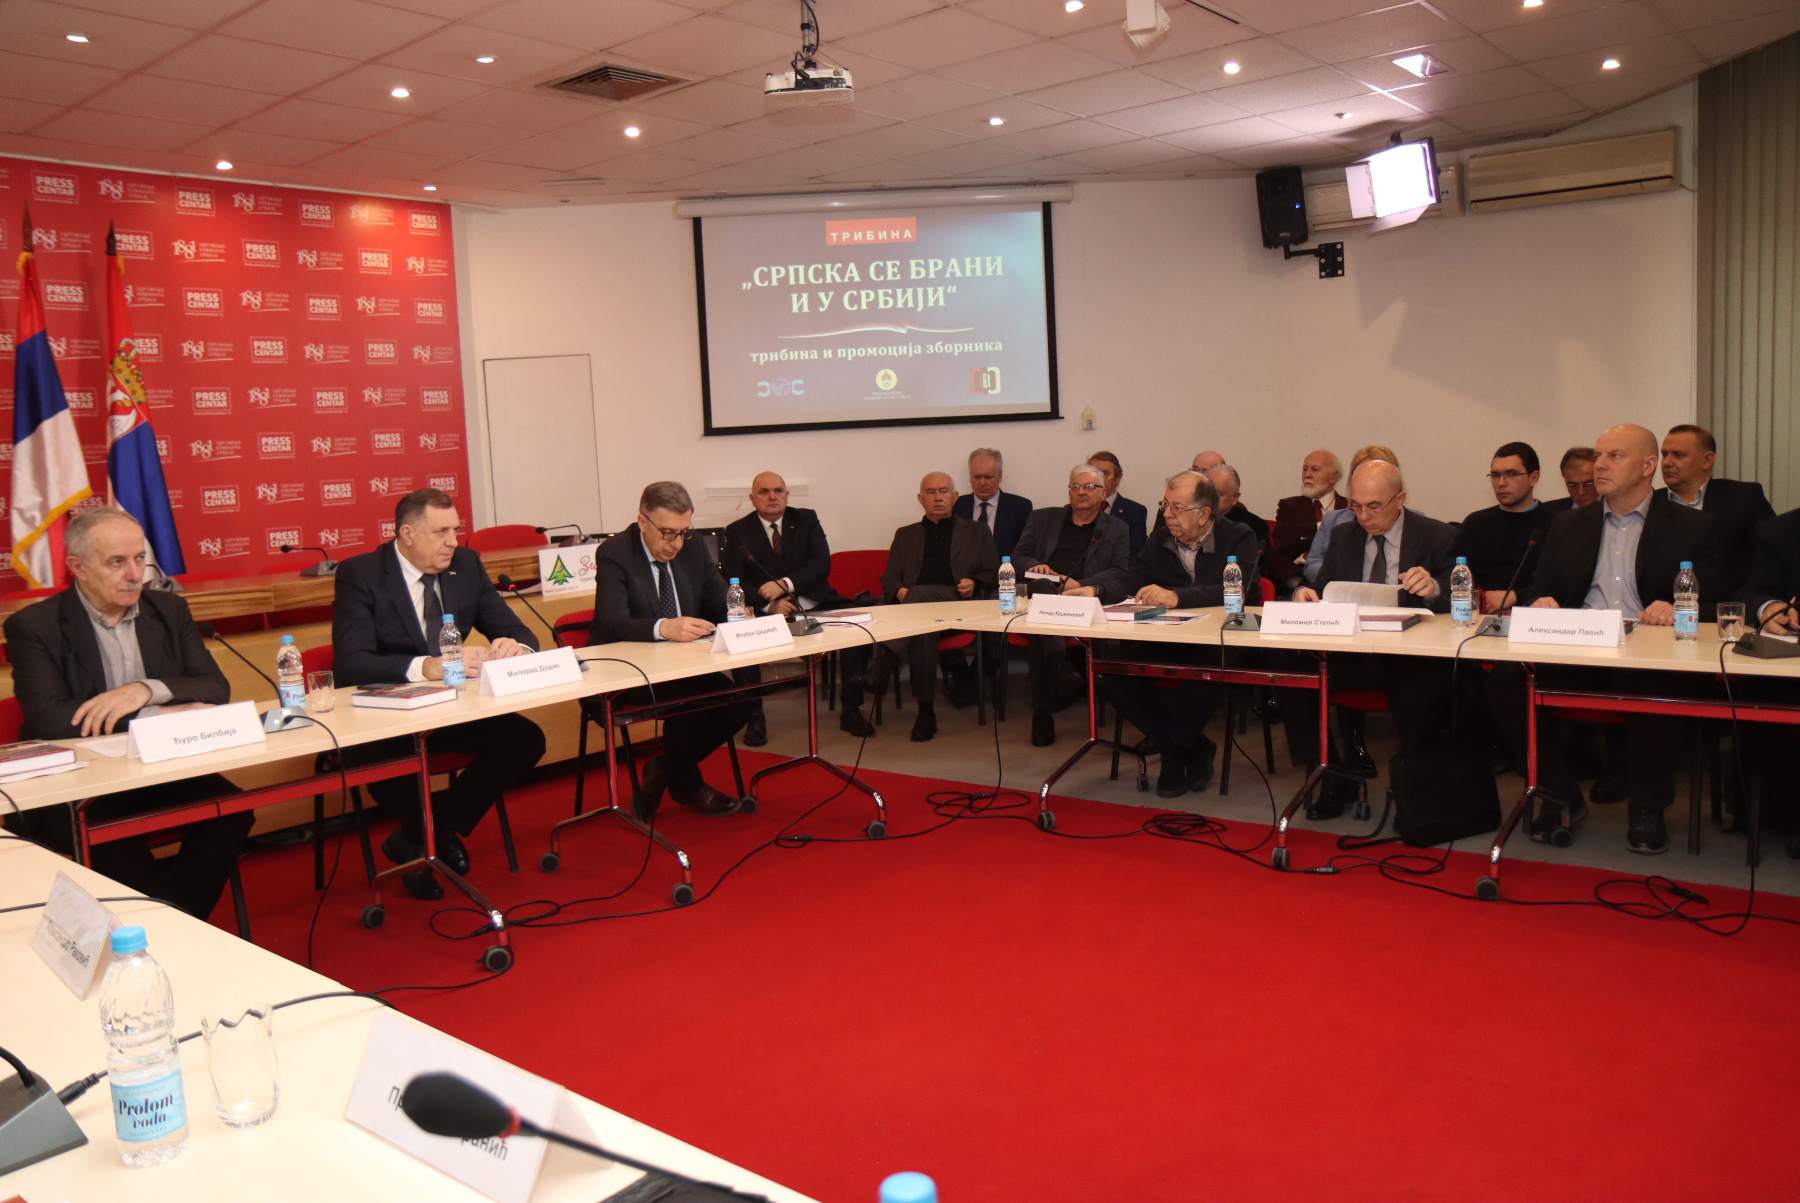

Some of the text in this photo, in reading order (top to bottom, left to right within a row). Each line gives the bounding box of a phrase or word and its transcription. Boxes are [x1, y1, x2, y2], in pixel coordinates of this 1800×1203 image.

[36, 176, 74, 189] PRESS
[36, 186, 75, 196] CENTAR
[178, 191, 211, 203] PRESS
[179, 200, 212, 210] CENTAR
[302, 203, 331, 214] PRESS
[303, 212, 332, 221] CENTAR
[411, 213, 437, 224] PRESS
[412, 222, 438, 230] CENTAR
[115, 234, 149, 245] PRESS
[831, 229, 913, 242] ТРИБИНА
[116, 243, 150, 253] CENTAR
[246, 244, 276, 254] PRESS
[246, 252, 277, 261] CENTAR
[361, 252, 388, 262] PRESS
[361, 260, 389, 269] CENTAR
[742, 256, 1004, 290] „СРПСКА СЕ БРАНИ
[46, 285, 84, 296] PRESS
[46, 294, 85, 304] CENTAR
[187, 292, 218, 302] PRESS
[790, 285, 957, 314] И У СРБИЈИ“
[187, 300, 220, 309] CENTAR
[309, 298, 337, 308] PRESS
[417, 303, 442, 312] PRESS
[309, 306, 338, 315] CENTAR
[417, 310, 443, 318] CENTAR
[253, 341, 284, 351] PRESS
[368, 344, 394, 353] PRESS
[254, 349, 284, 357] CENTAR
[368, 351, 395, 359] CENTAR
[750, 341, 1003, 365] трибина и промоција зборника
[195, 391, 227, 401] PRESS
[316, 391, 344, 400] PRESS
[423, 390, 448, 399] PRESS
[196, 400, 228, 408] CENTAR
[316, 399, 345, 407] CENTAR
[261, 436, 291, 446] PRESS
[374, 433, 401, 442] PRESS
[262, 445, 292, 453] CENTAR
[375, 441, 402, 449] CENTAR
[430, 477, 455, 486] PRESS
[324, 483, 351, 492] PRESS
[204, 489, 236, 499] PRESS
[324, 490, 352, 499] CENTAR
[205, 498, 236, 507] CENTAR
[269, 531, 299, 540] PRESS
[270, 539, 299, 548] CENTAR
[1528, 626, 1604, 636] Александар Павић
[506, 663, 560, 678] Милорад Додик
[172, 727, 237, 746] Ђуро Билбија
[119, 1093, 173, 1116] Prolom
[133, 1112, 166, 1129] voda
